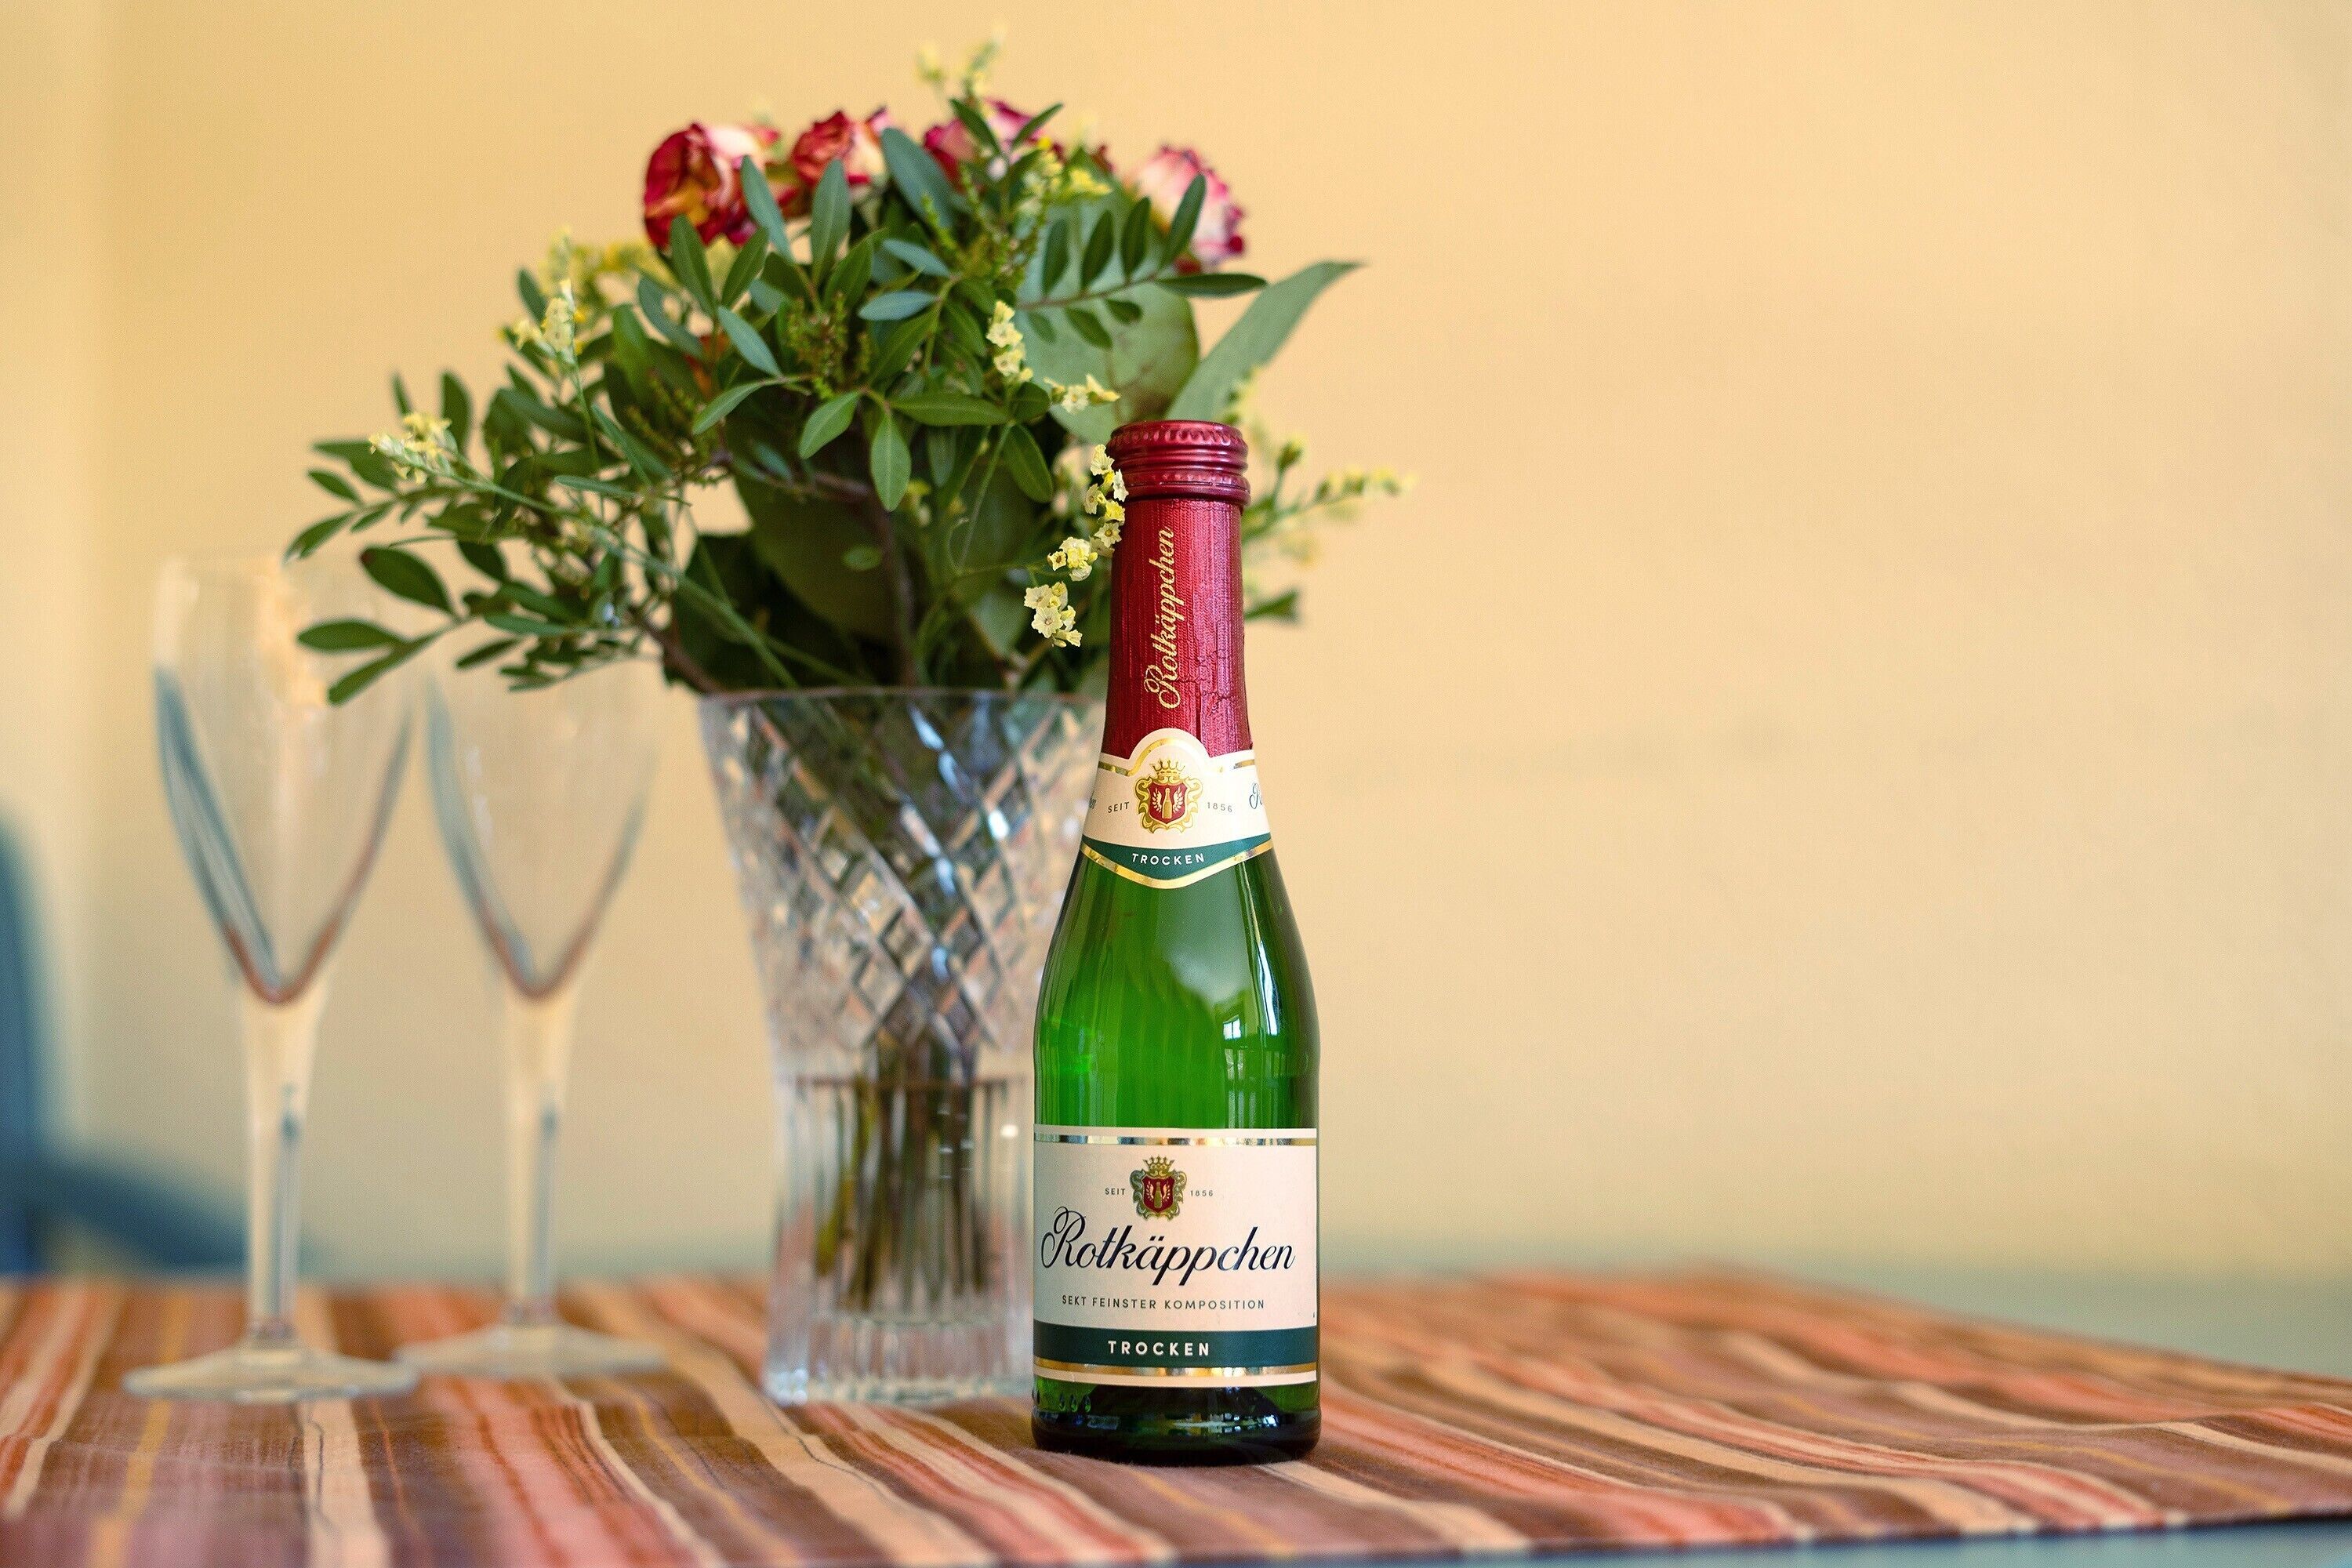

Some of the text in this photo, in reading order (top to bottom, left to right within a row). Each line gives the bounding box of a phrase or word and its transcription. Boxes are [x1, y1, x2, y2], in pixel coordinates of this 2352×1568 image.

[1143, 526, 1185, 710] Rotkäppchen
[1108, 801, 1232, 814] SEIT 1856
[1131, 853, 1205, 866] TROCKEN
[1041, 1206, 1295, 1286] Rotkäppchen
[1062, 1294, 1265, 1310] SEKT FEINSTER KOMPOSITION
[1108, 1340, 1210, 1357] TROCKEN
